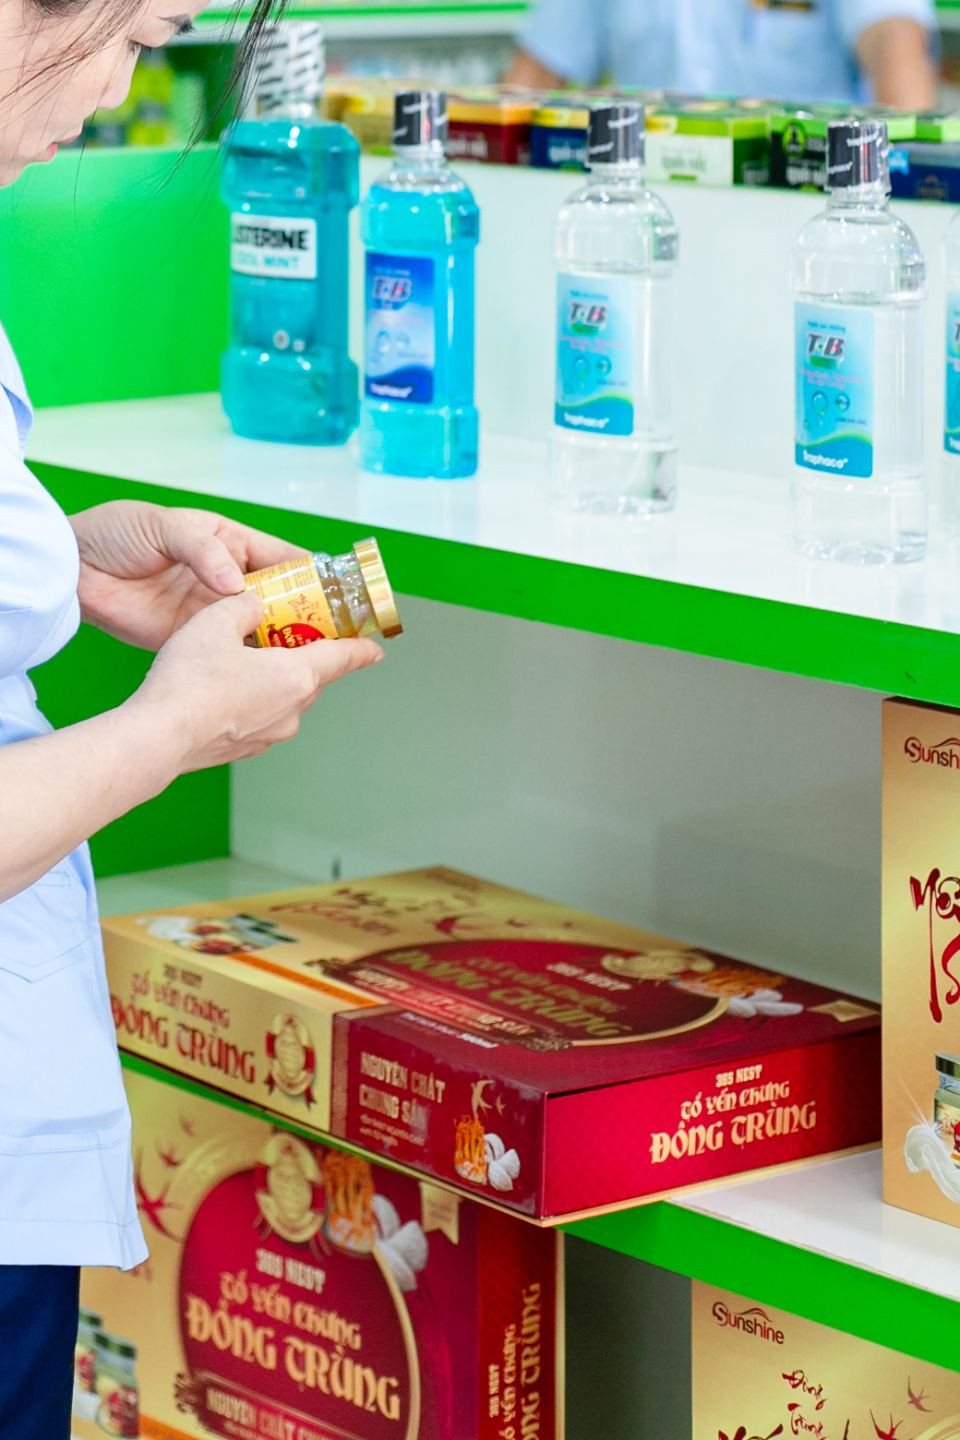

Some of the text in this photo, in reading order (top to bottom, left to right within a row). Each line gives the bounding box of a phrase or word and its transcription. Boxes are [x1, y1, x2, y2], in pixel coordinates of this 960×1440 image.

[735, 1064, 763, 1083] NEST
[731, 1100, 817, 1150] TRÙNG
[712, 1300, 785, 1345] Sunshine
[283, 1335, 400, 1421] TRÙNG
